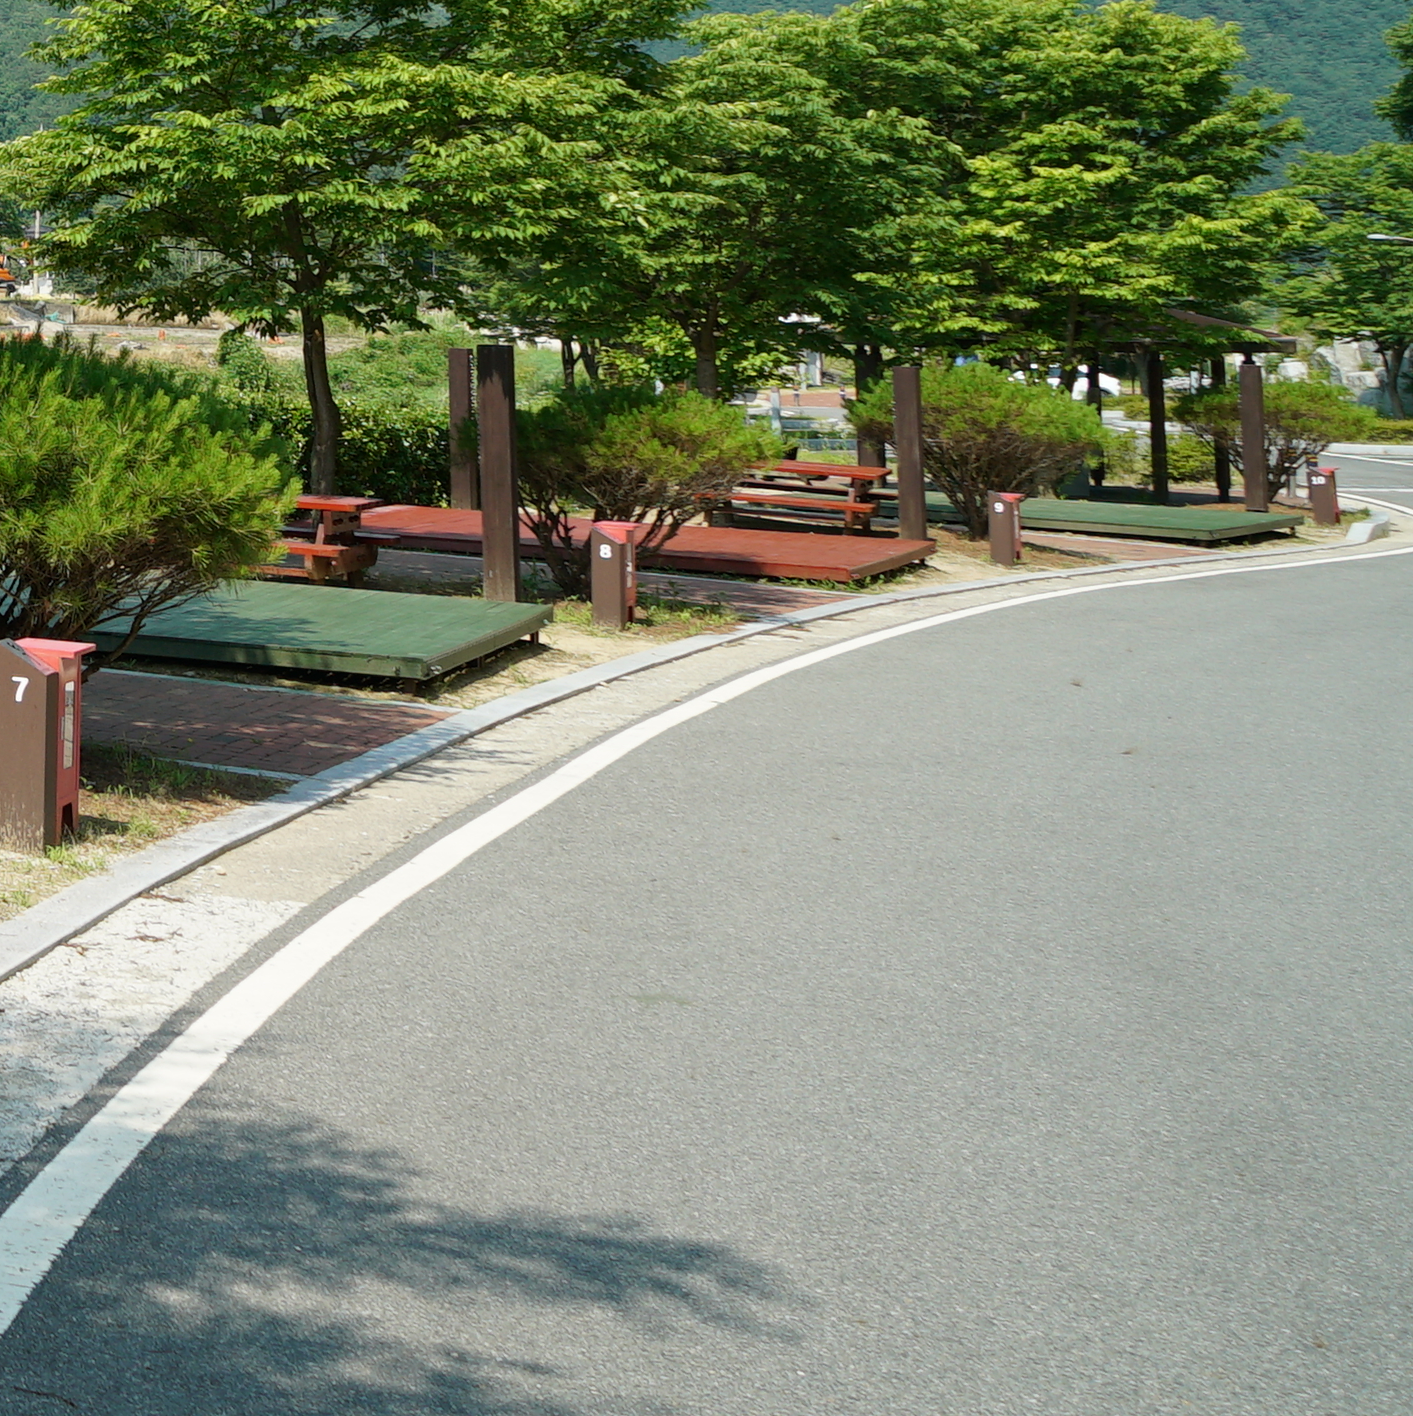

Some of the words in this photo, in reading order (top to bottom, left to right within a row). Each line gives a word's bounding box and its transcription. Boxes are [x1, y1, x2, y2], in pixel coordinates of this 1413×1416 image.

[1311, 476, 1326, 485] 10
[994, 502, 1004, 513] 9
[599, 544, 612, 559] 8
[11, 676, 29, 702] 7
